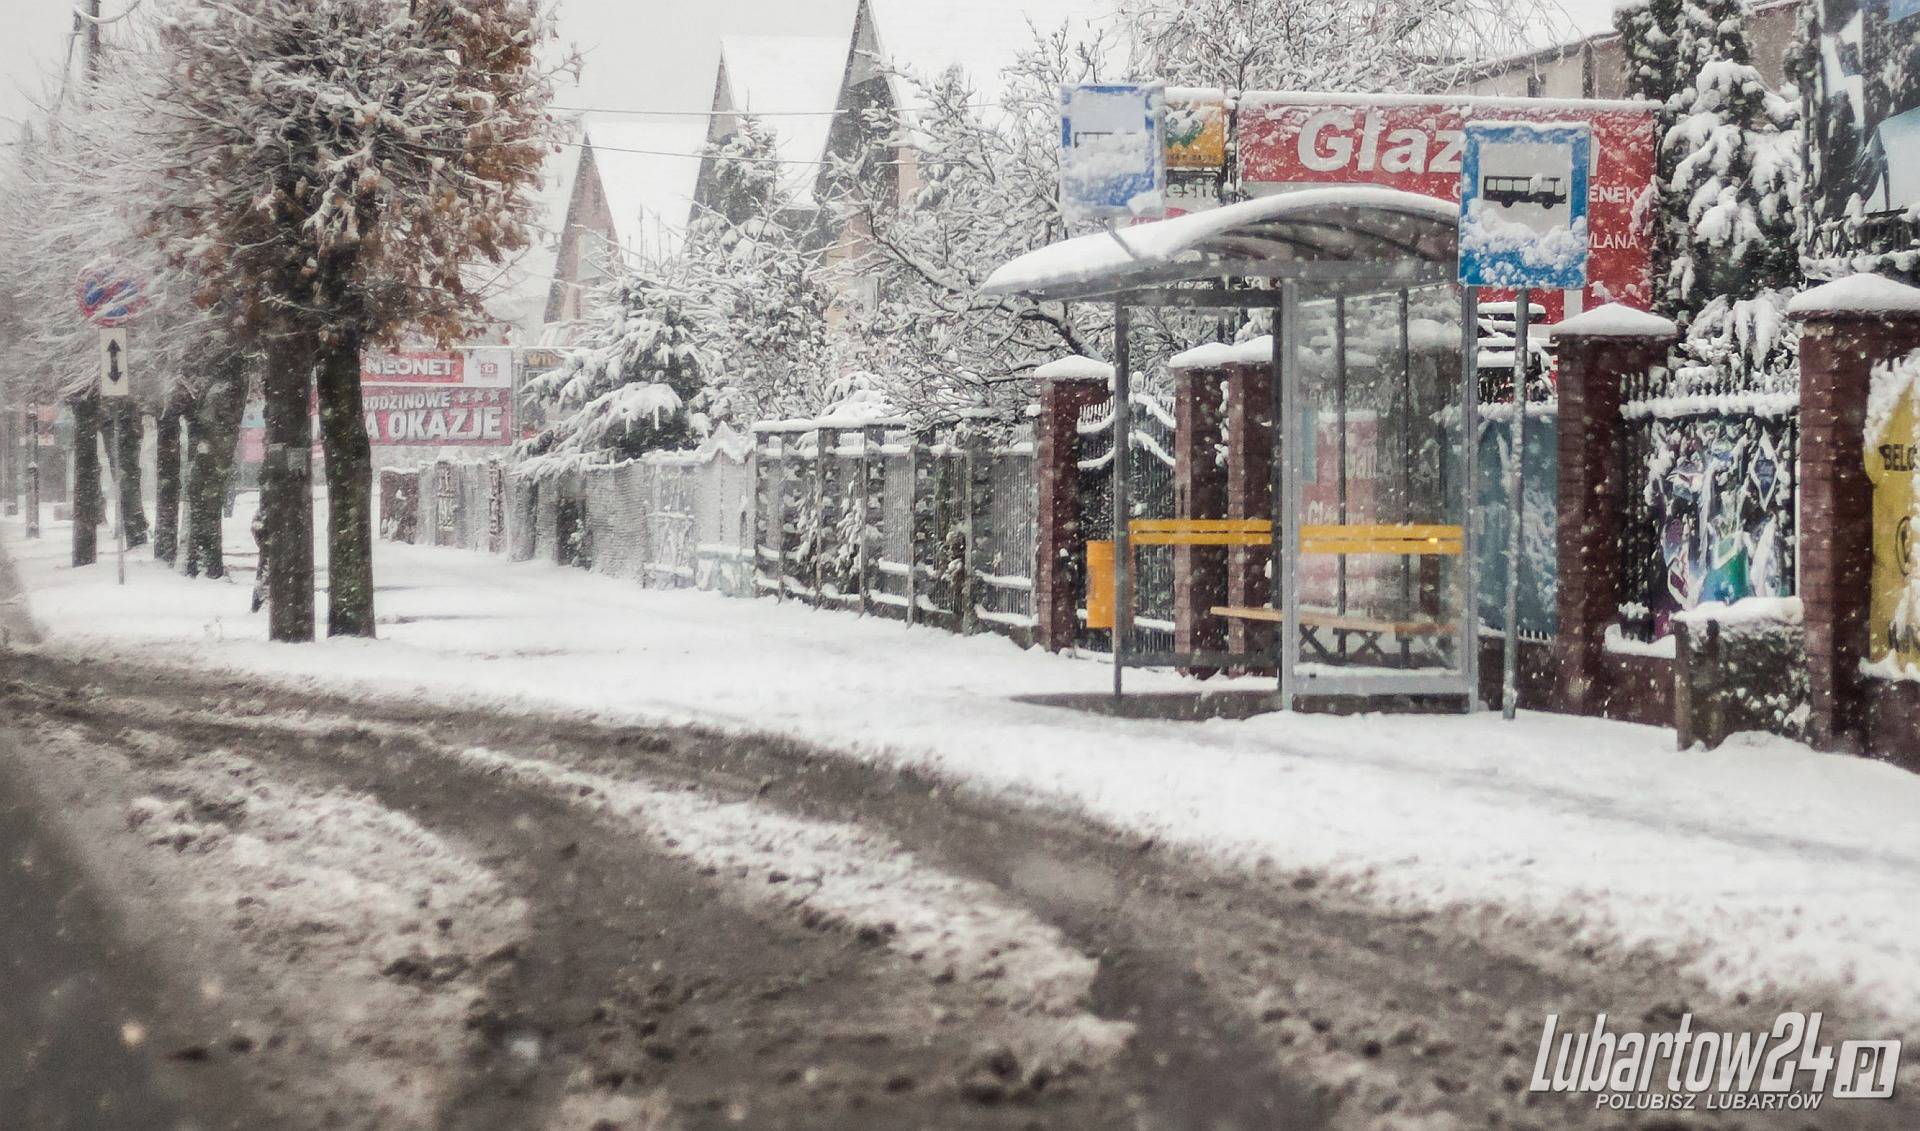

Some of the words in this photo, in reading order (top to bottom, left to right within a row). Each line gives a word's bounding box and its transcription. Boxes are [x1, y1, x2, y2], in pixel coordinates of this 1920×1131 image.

[1588, 231, 1639, 249] LANA
[366, 357, 455, 376] NEONET
[388, 407, 502, 440] OKAZJE
